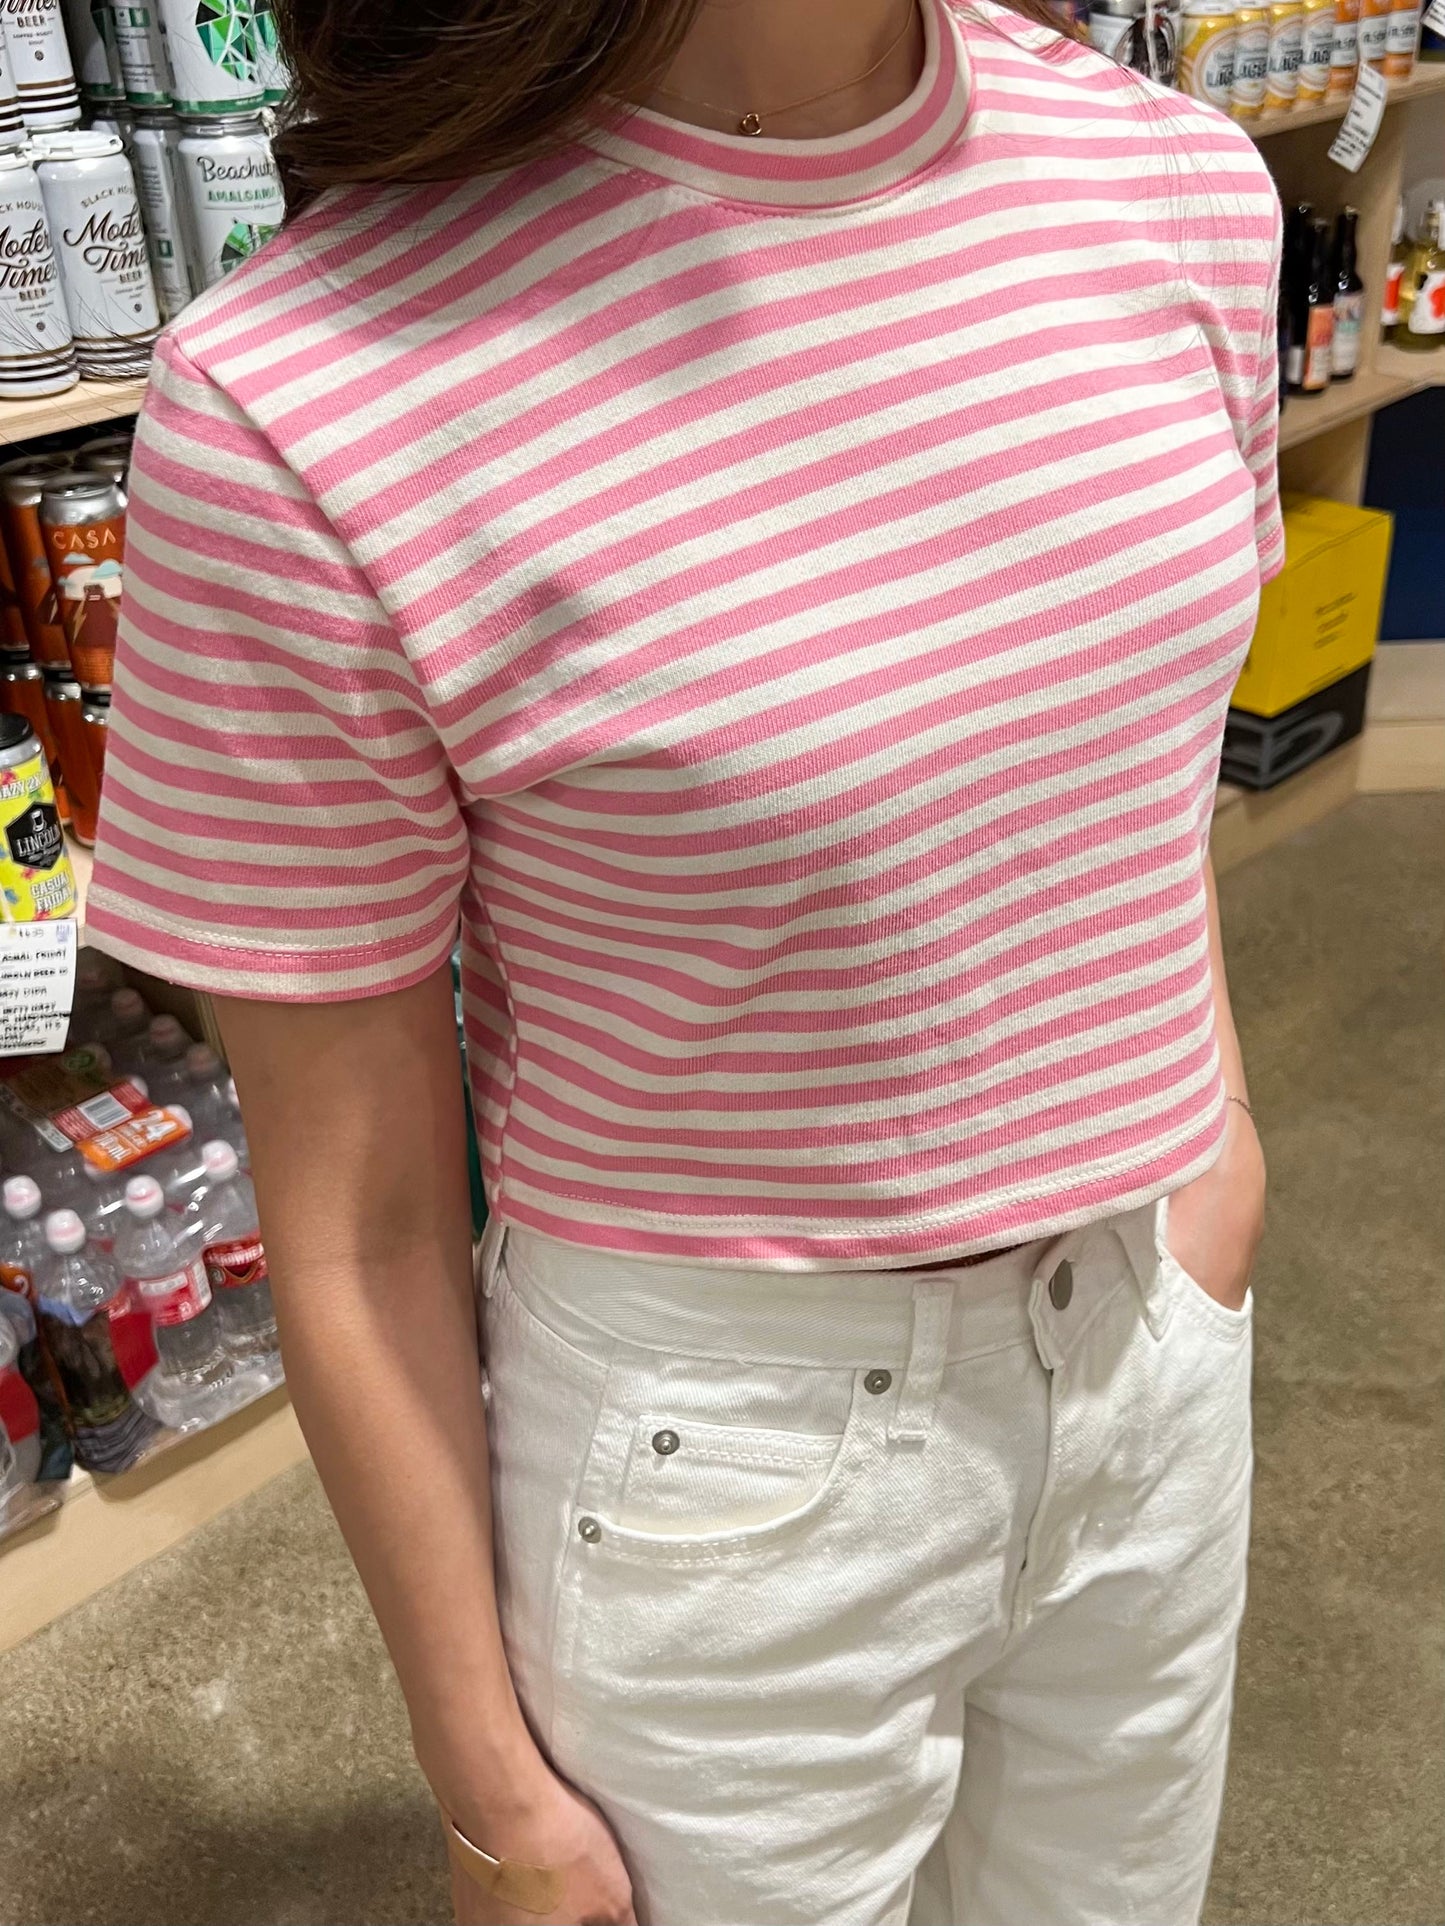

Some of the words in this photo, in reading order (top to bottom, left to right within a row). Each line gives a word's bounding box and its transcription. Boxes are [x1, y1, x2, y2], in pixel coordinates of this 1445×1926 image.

[17, 15, 46, 27] BEER
[119, 271, 143, 284] BEER
[19, 287, 46, 301] BEER
[53, 527, 117, 550] CASA
[0, 780, 26, 799] AZY
